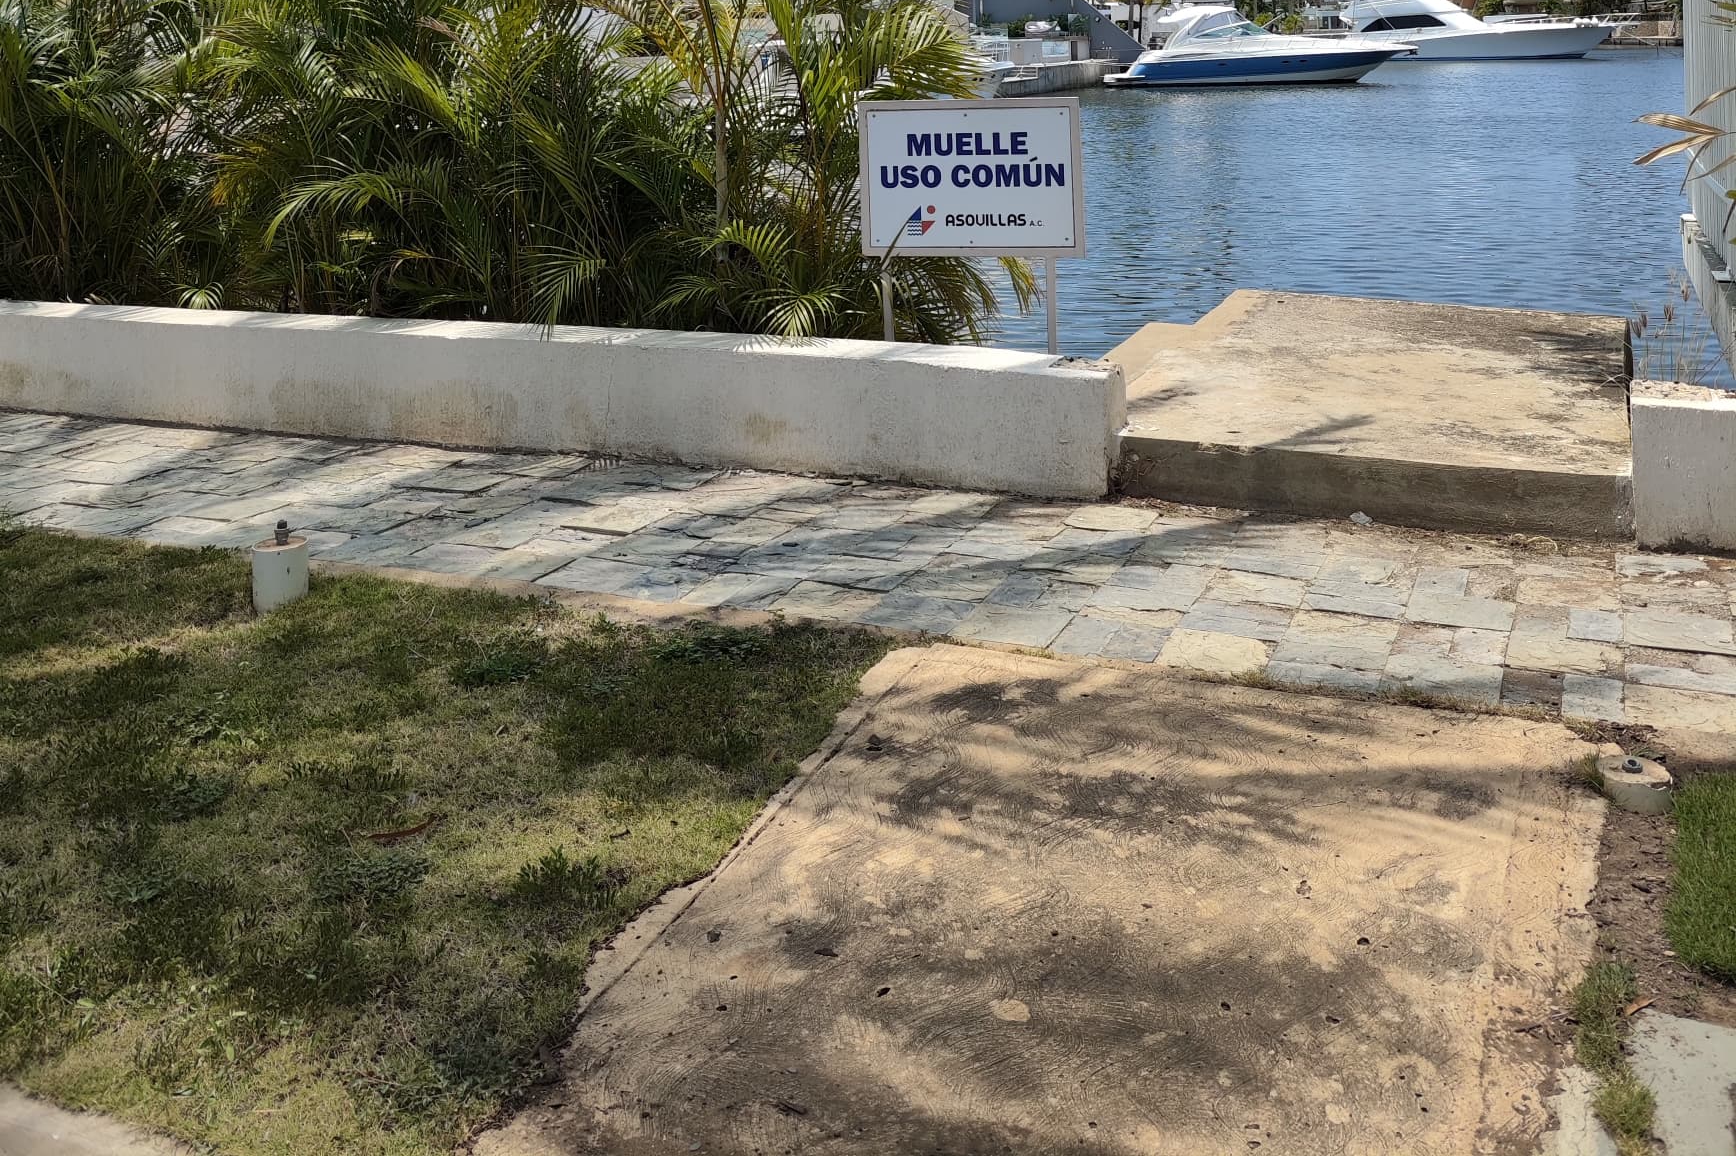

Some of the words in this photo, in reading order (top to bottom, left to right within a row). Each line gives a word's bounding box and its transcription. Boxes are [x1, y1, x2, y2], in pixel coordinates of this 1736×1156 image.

[906, 131, 1029, 157] MUELLE
[880, 164, 942, 189] USO
[951, 156, 1065, 188] COMÚN
[945, 213, 1027, 227] ASOVILLAS
